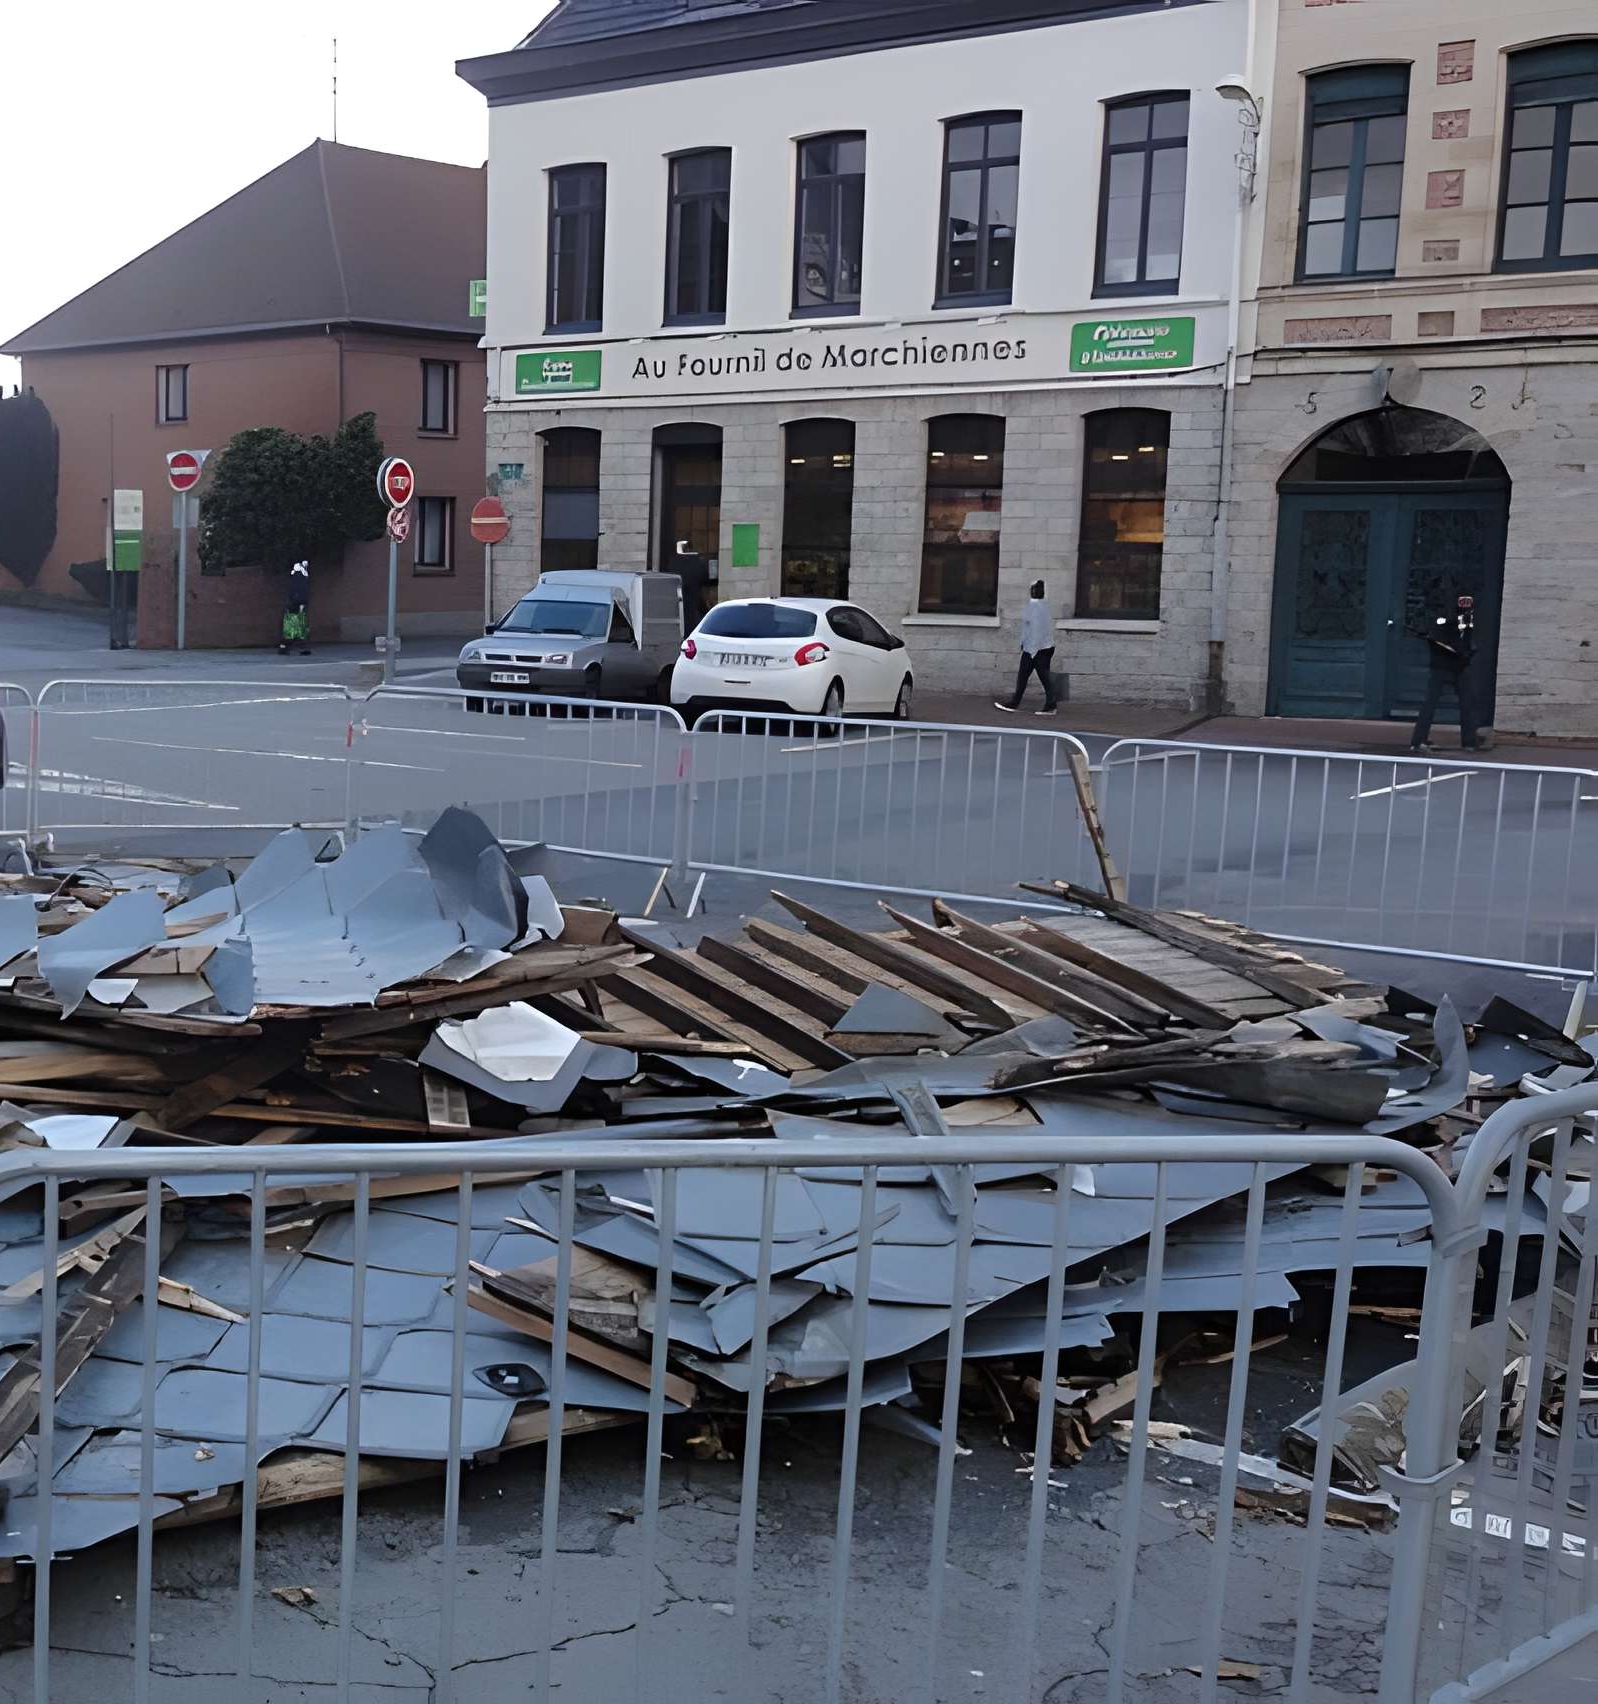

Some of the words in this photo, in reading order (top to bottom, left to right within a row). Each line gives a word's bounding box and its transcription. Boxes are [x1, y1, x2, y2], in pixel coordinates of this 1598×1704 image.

[631, 356, 666, 379] Au
[677, 347, 765, 376] Fournil
[776, 347, 812, 371] de
[821, 336, 1027, 369] Marchiennes
